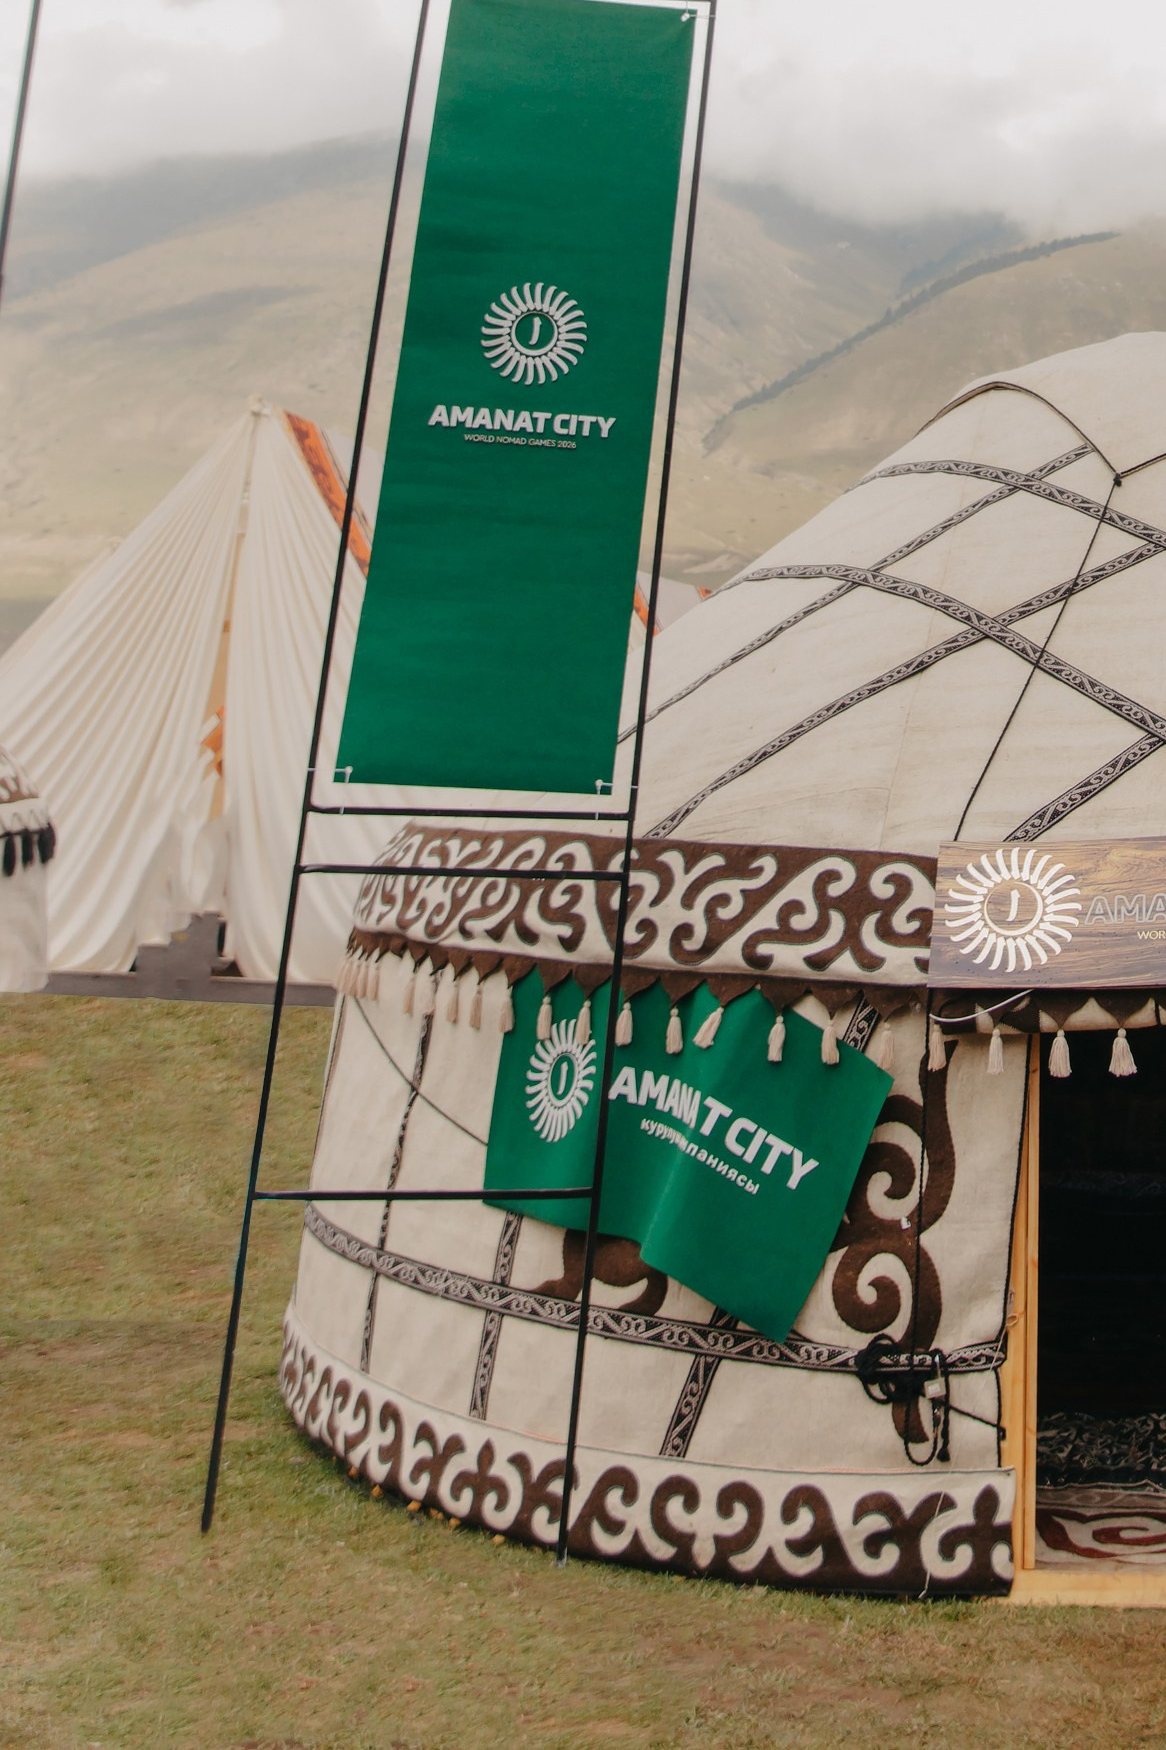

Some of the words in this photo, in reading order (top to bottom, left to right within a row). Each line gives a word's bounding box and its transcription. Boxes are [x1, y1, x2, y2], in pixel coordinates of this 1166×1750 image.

[428, 404, 552, 434] AMANAT
[553, 413, 617, 438] CITY
[464, 433, 495, 443] WORLD
[496, 436, 527, 445] NOMAD
[528, 438, 556, 447] GAMES
[557, 440, 577, 449] 2026
[608, 1066, 734, 1137] AMANAT
[724, 1117, 820, 1190] CITY
